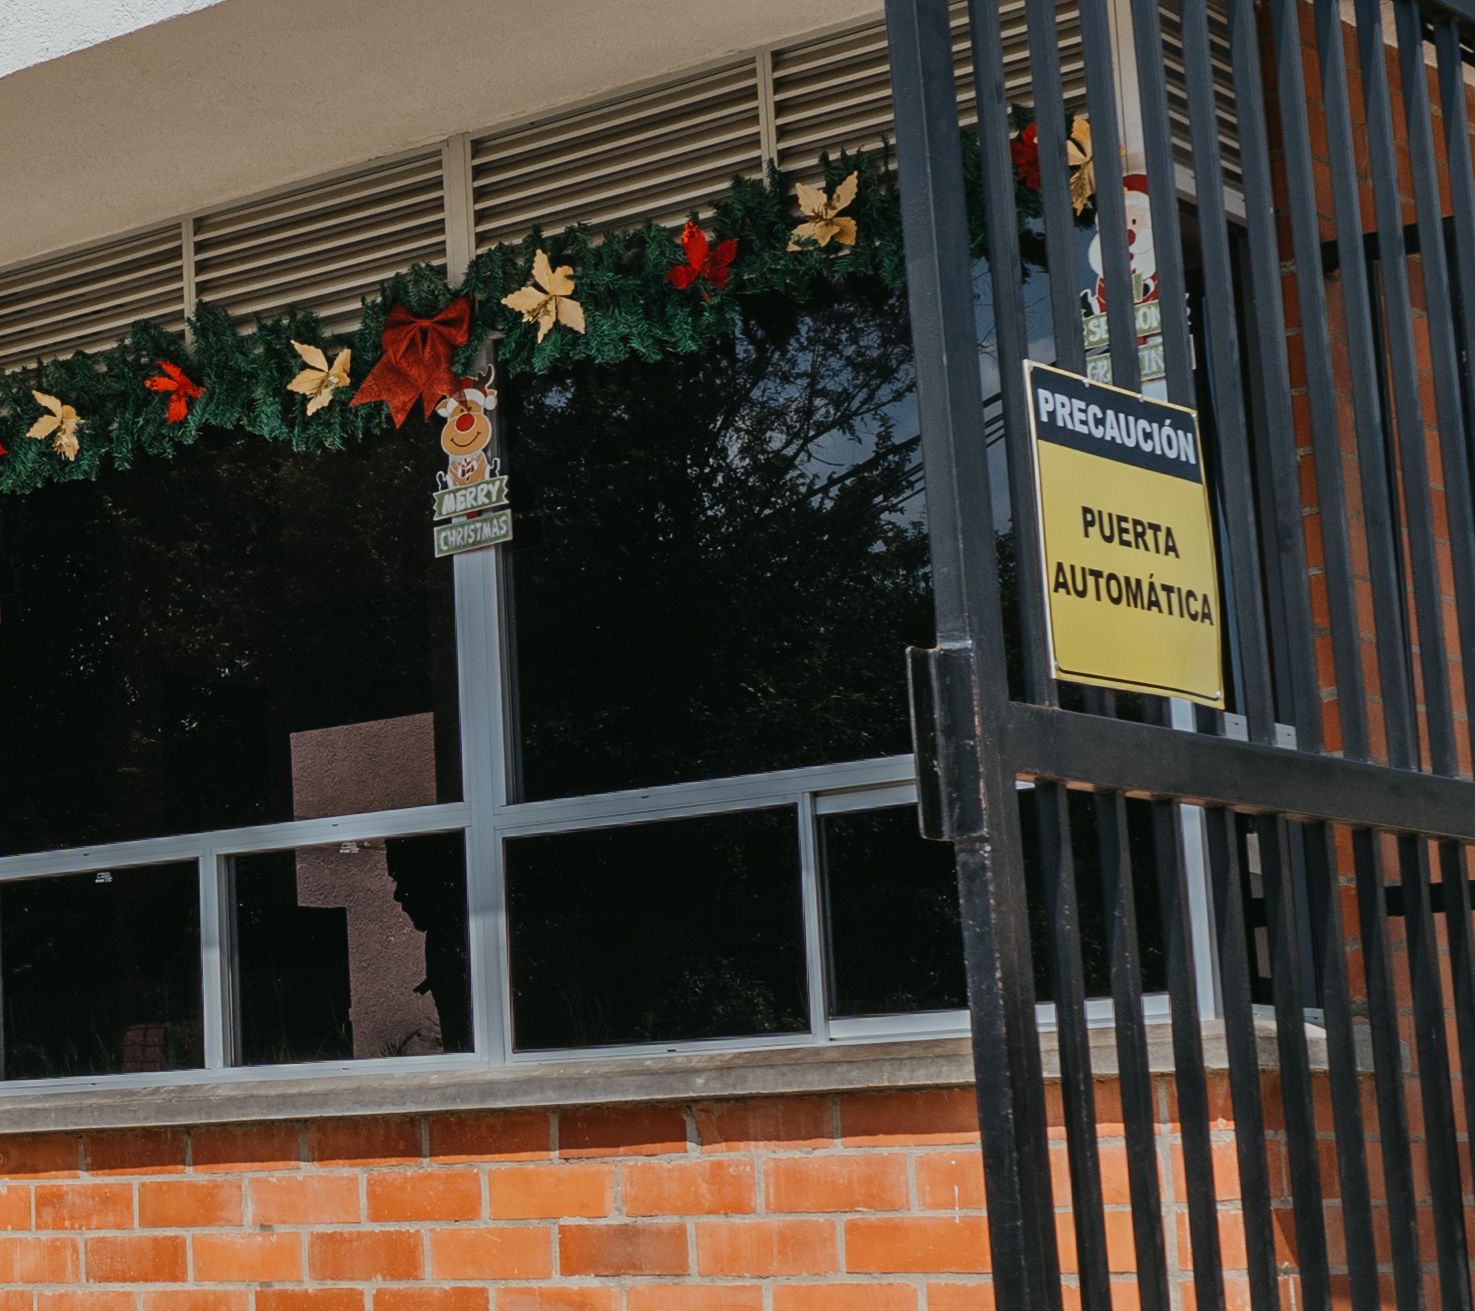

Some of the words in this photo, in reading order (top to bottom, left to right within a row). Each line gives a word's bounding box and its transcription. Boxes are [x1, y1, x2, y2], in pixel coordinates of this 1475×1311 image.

[1036, 388, 1197, 465] PRECAUCIÓN
[441, 480, 501, 515] MERRY
[439, 516, 507, 551] CHRISTMAS
[1081, 505, 1180, 559] PUERTA
[1053, 561, 1215, 626] AUTOMÁTICA
